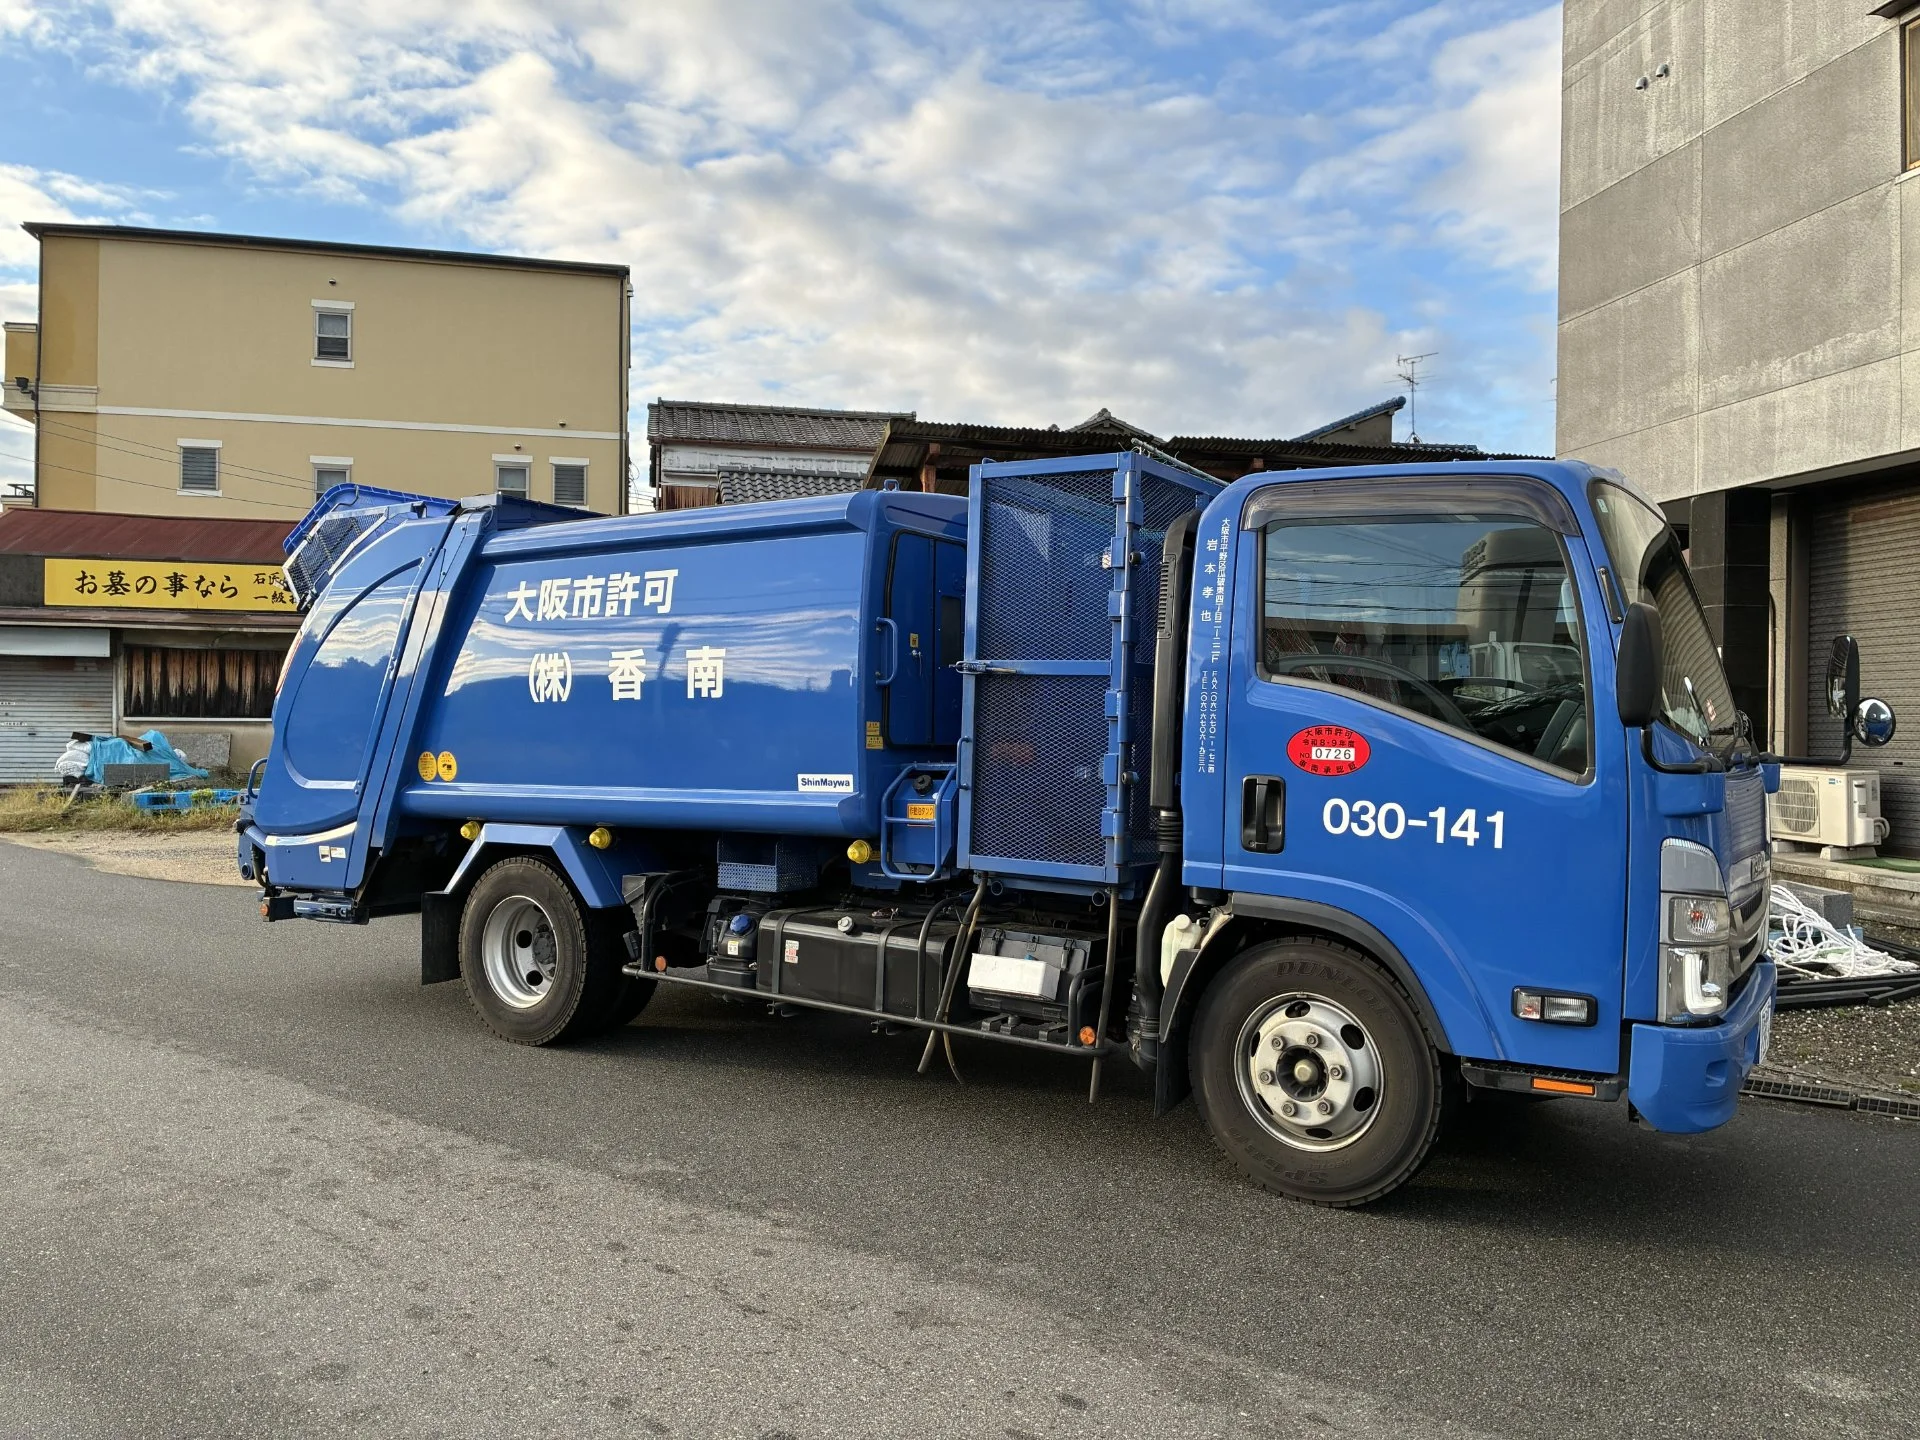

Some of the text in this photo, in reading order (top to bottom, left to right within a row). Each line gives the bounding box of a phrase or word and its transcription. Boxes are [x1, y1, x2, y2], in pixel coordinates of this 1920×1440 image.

[74, 569, 239, 598] お墓の事なら
[504, 568, 679, 624] 大阪市許可
[1200, 538, 1219, 622] 岩本孝也
[1315, 748, 1351, 760] 0726
[800, 777, 850, 789] ShinMaywa
[1322, 798, 1504, 849] 030-141
